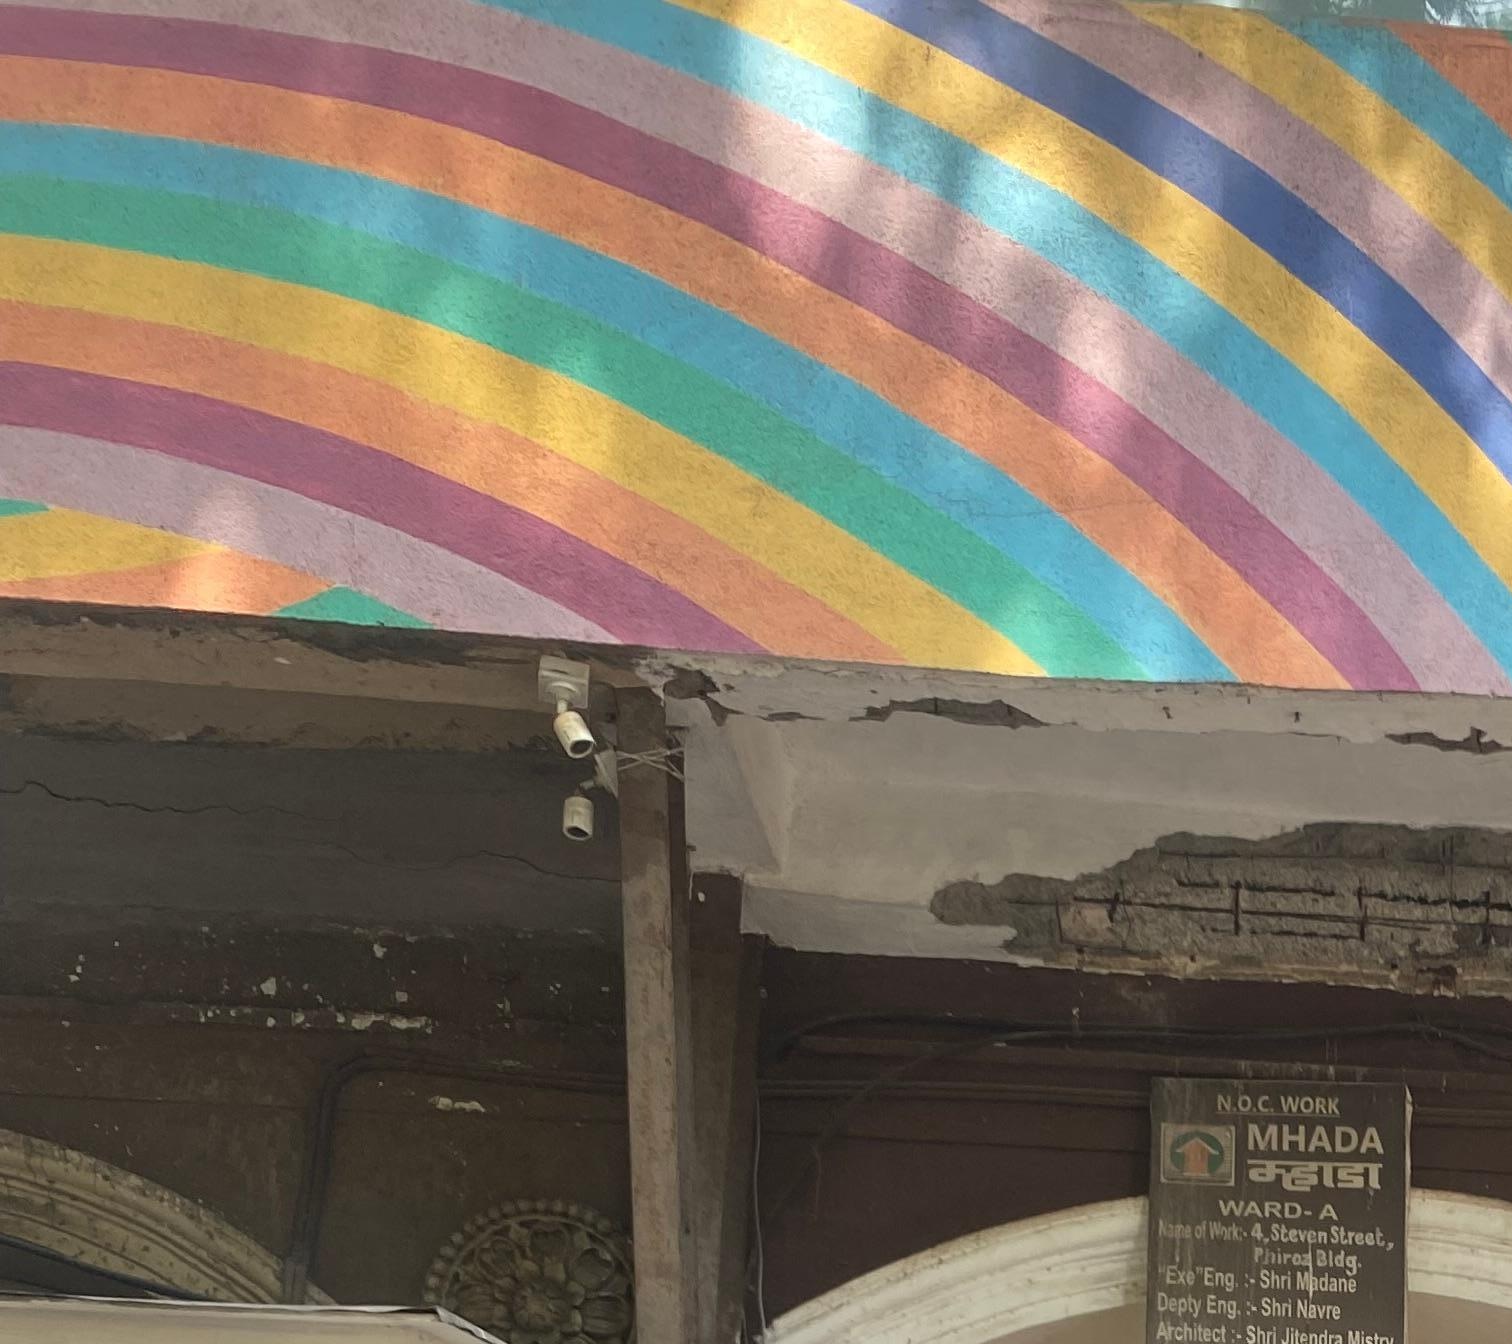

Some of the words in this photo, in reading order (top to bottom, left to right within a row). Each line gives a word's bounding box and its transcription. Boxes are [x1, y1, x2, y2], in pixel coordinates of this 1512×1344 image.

[1216, 1094, 1274, 1113] N.O.C.
[1281, 1096, 1340, 1115] WORK
[1248, 1123, 1384, 1155] MHADA
[1246, 1159, 1384, 1192] म्हाडा
[1158, 1221, 1191, 1239] Name
[1194, 1222, 1207, 1240] of
[1316, 1250, 1363, 1277] Bldg.
[1259, 1269, 1291, 1289] Shri
[1297, 1271, 1357, 1293] Madane
[1157, 1292, 1200, 1317] Depty
[1206, 1295, 1241, 1319] Eng.
[1261, 1297, 1292, 1317] Shri
[1297, 1299, 1341, 1320] Navre
[1156, 1321, 1227, 1344] Architect
[1245, 1325, 1276, 1344] Shri
